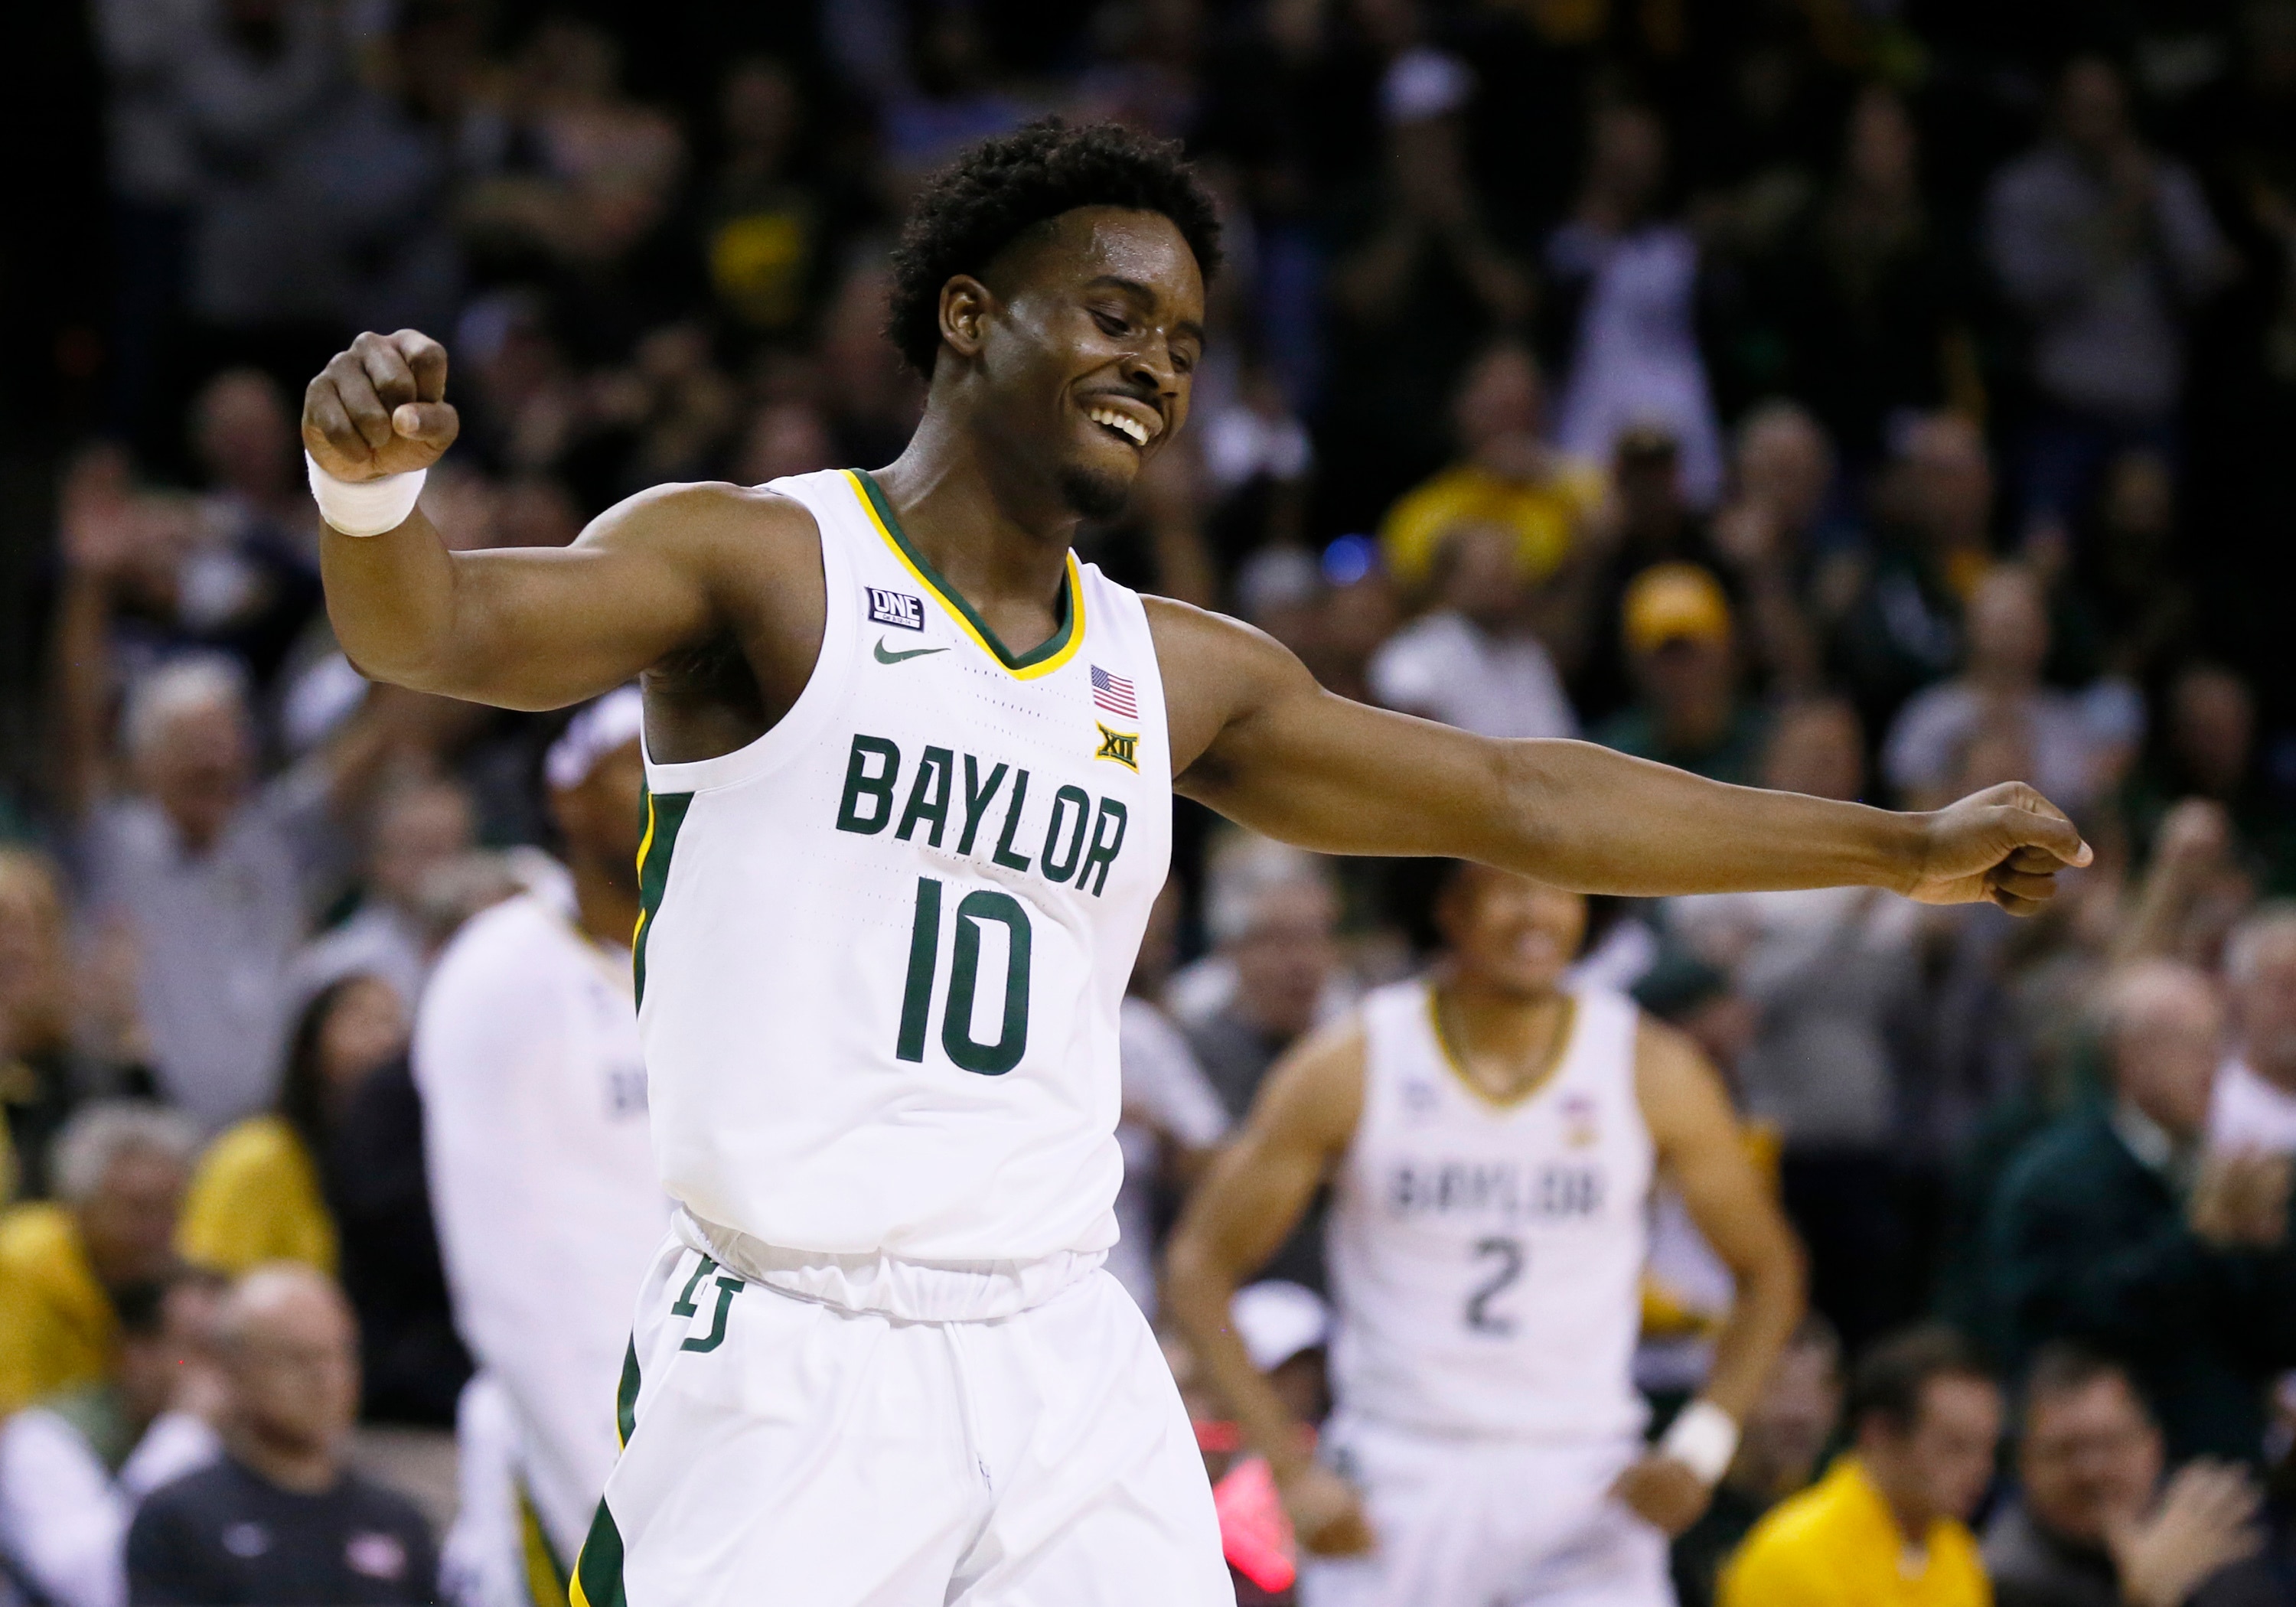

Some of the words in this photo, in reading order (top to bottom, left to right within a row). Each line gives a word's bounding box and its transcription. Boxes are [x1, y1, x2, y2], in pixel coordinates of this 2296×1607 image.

[871, 589, 920, 621] ONE
[836, 733, 1127, 898] BAYLOR
[895, 876, 1032, 1076] 10
[1465, 1234, 1525, 1337] 2
